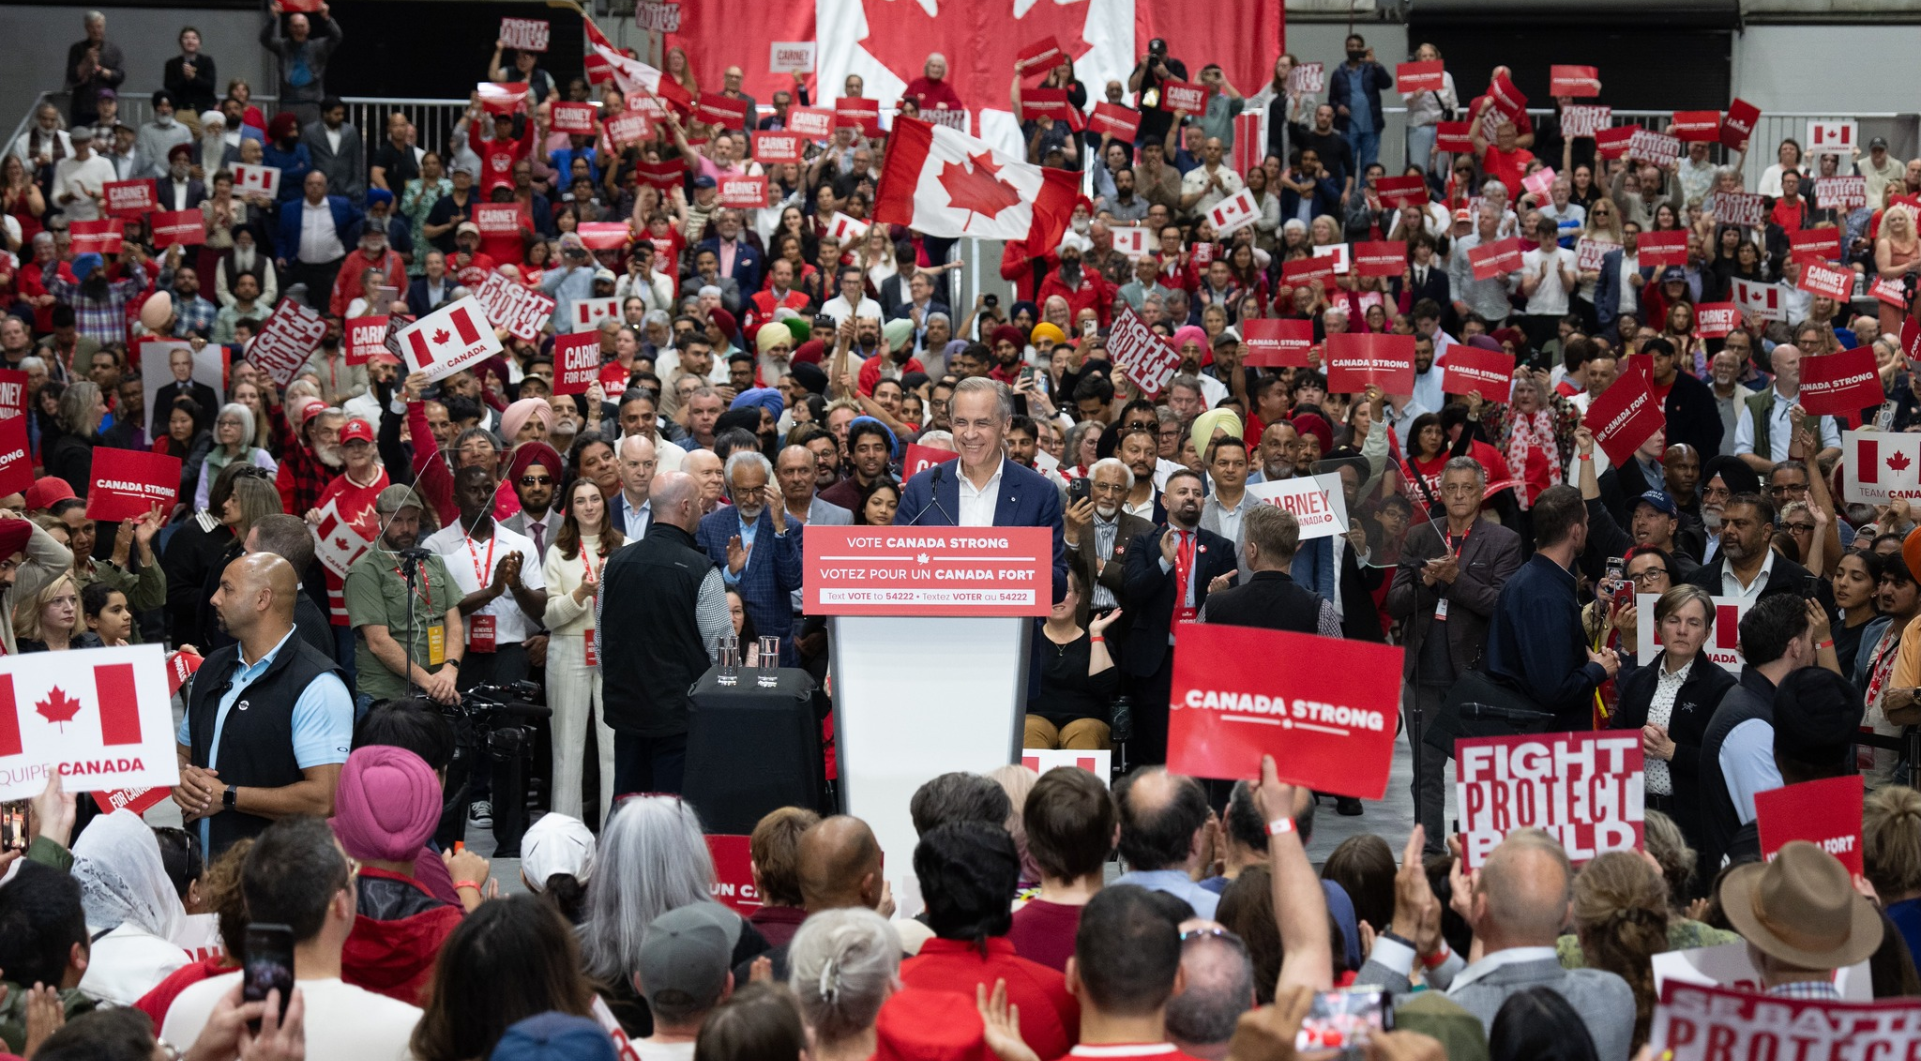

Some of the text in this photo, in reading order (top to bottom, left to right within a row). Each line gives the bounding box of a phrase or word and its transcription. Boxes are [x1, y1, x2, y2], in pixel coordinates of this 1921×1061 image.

[1166, 86, 1204, 103] CARNEY
[554, 108, 592, 121] CARNEY
[1562, 106, 1608, 119] FIGHT
[757, 136, 797, 150] CARNEY
[108, 185, 149, 201] CARNEY
[723, 181, 763, 195] CARNEY
[1714, 193, 1764, 206] FIGHT
[478, 210, 518, 223] CARNEY
[1806, 265, 1848, 290] CARNEY
[489, 271, 556, 314] FIGHT
[1698, 309, 1735, 324] CARNEY
[247, 299, 296, 369] FIGHT
[351, 326, 388, 345] CARN
[1119, 307, 1181, 365] FIGHT
[1247, 338, 1311, 348] CANADA STRONG
[270, 317, 328, 387] BUILD
[446, 344, 488, 368] CANADA
[564, 341, 600, 371] CARNE
[1332, 357, 1410, 371] CANADA STRONG
[564, 371, 580, 385] FOR
[1448, 363, 1510, 385] CANADA STRONG
[1832, 371, 1874, 388] STRONG
[0, 382, 22, 408] NEY
[1596, 429, 1607, 443] UN
[1604, 407, 1632, 435] CANADA
[1629, 391, 1648, 412] FORT
[0, 449, 25, 467] ONG
[96, 478, 176, 498] CANADA STRONG
[1859, 487, 1921, 499] TEAM CANA
[1262, 489, 1330, 515] ARNEY
[1298, 516, 1323, 531] ANADA
[846, 536, 1009, 550] VOTE CANADA STRONG
[819, 568, 1036, 581] VOTEZ POUR UN CANADA FORT
[827, 591, 1028, 602] Text VOTE to 54222 Textez VOTER au 54222
[1185, 689, 1384, 732] CANADA STRONG
[1462, 738, 1638, 784] FIGHT
[0, 757, 146, 787] QUIPE CANADA
[108, 791, 126, 811] FOR
[1465, 771, 1633, 832] PROTECT
[1823, 834, 1856, 855] FORT
[709, 883, 735, 896] UN
[1672, 987, 1745, 1020] SE
